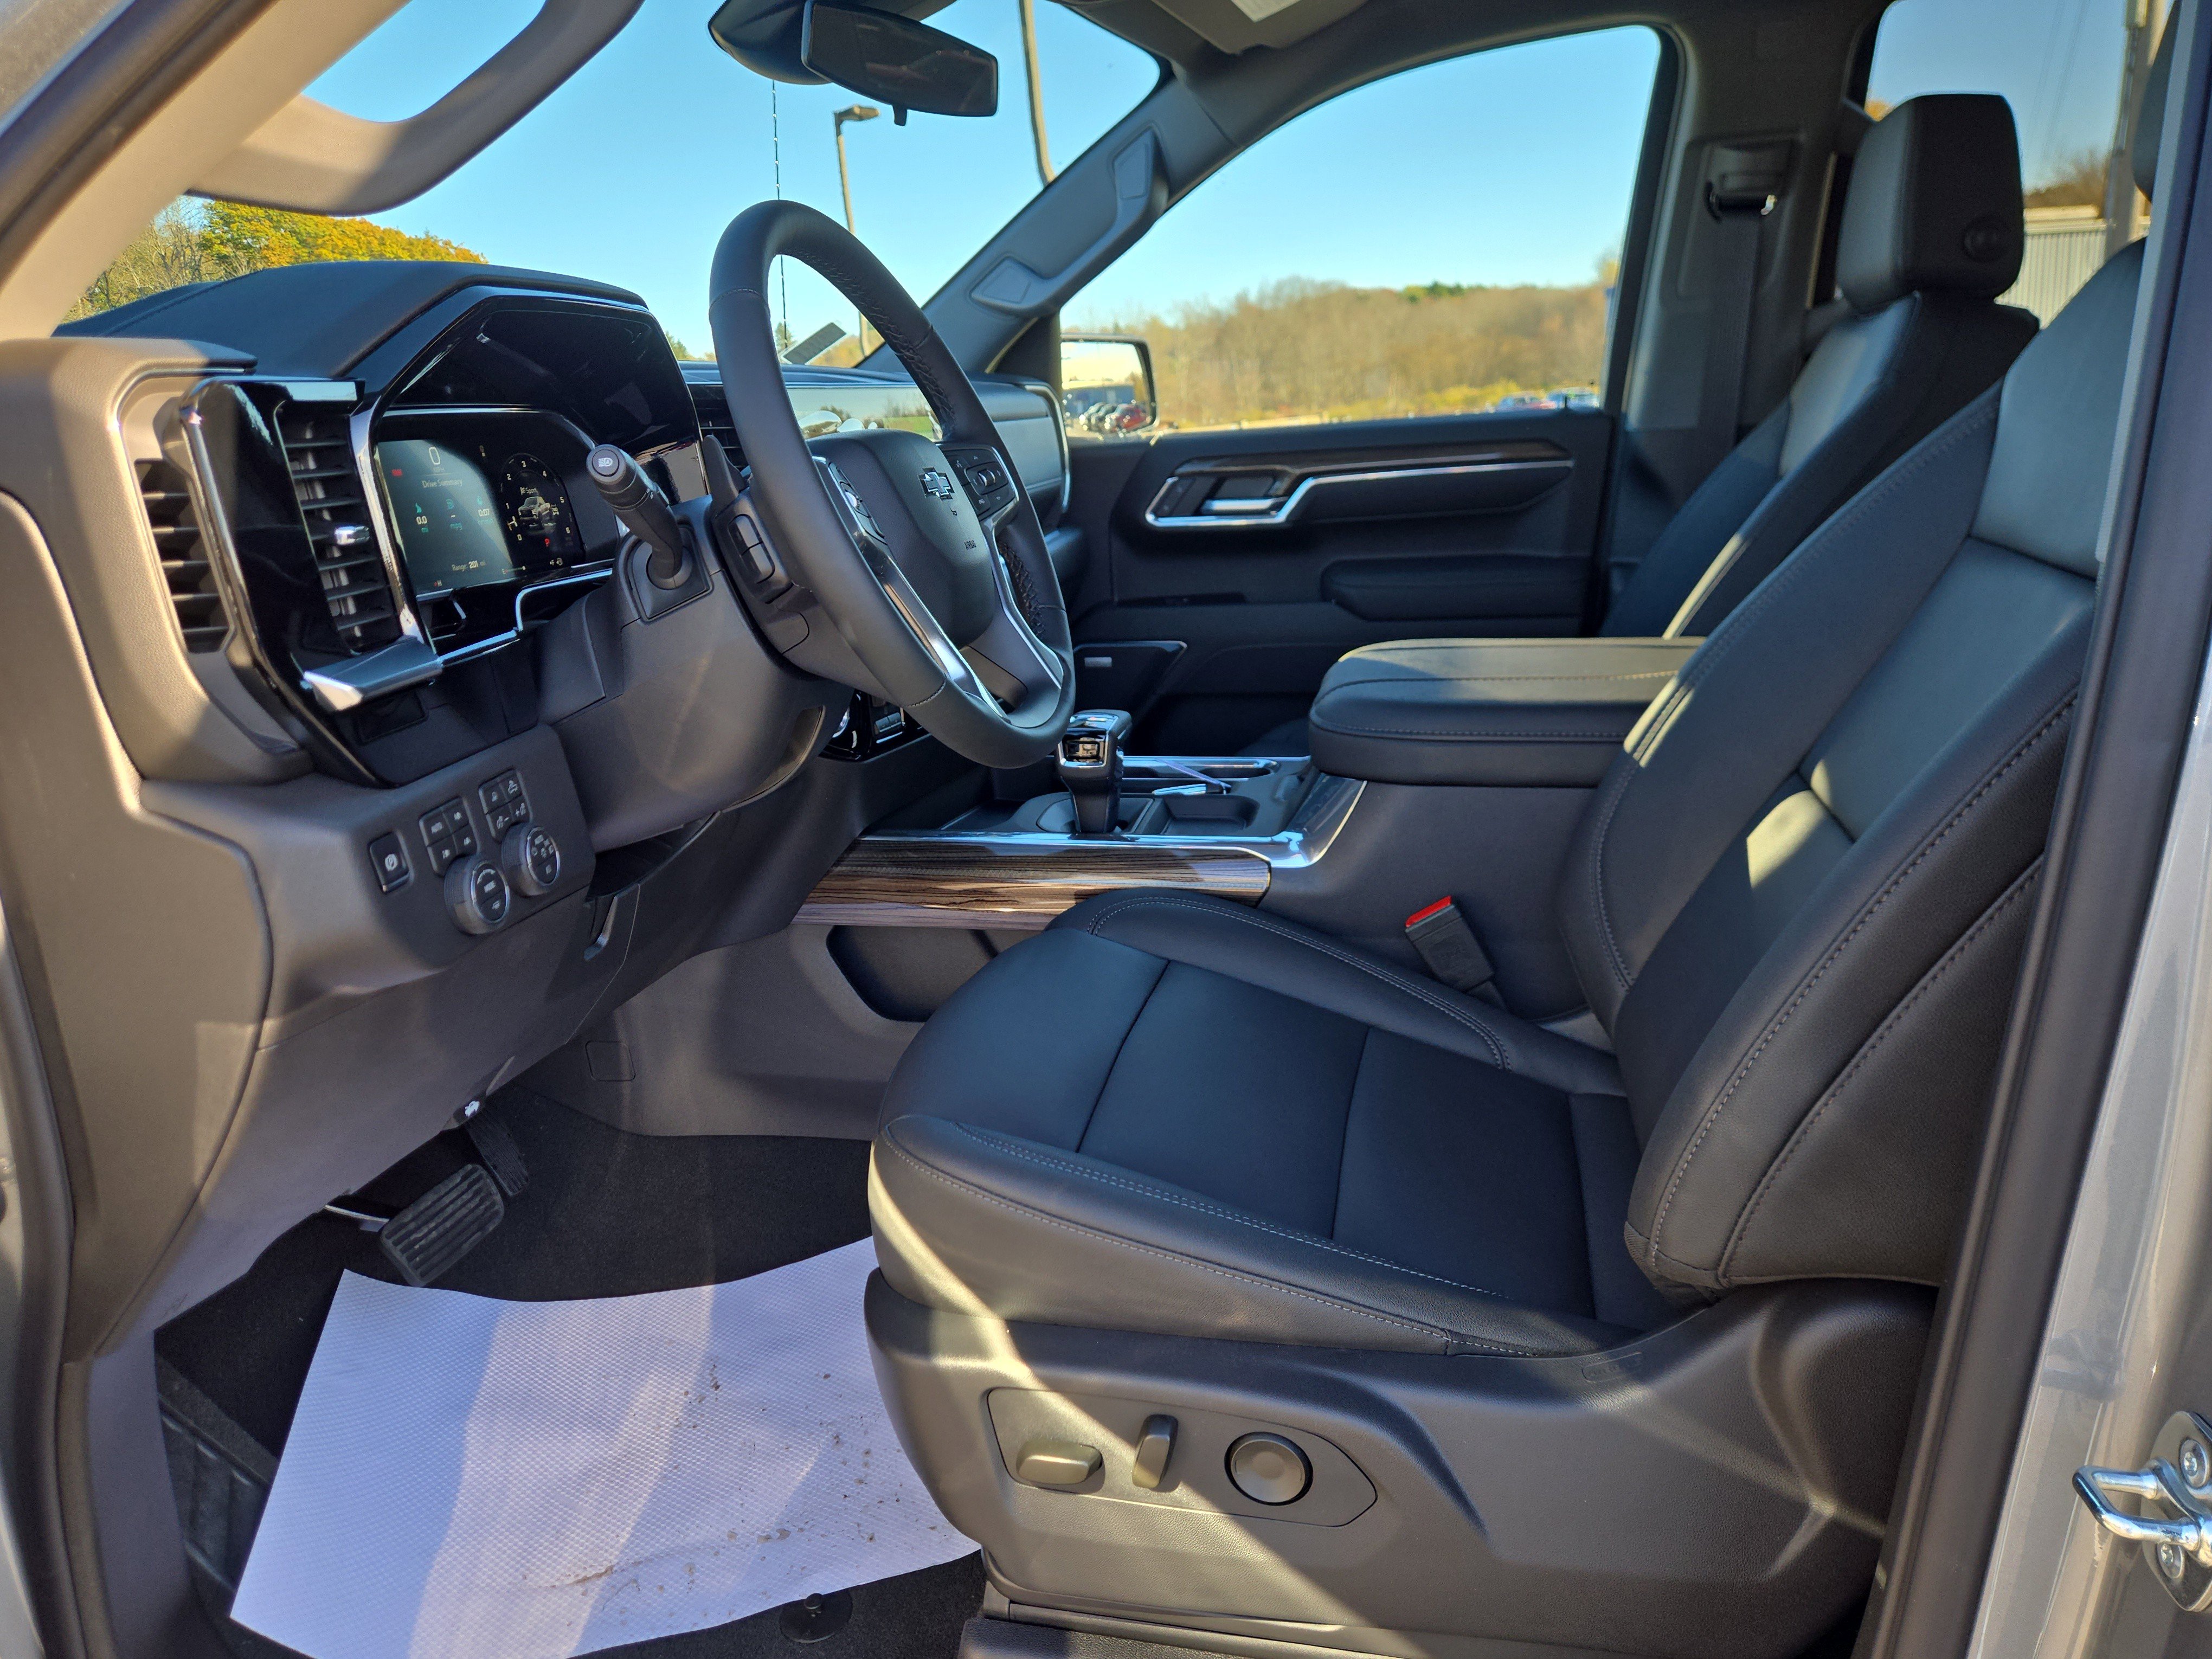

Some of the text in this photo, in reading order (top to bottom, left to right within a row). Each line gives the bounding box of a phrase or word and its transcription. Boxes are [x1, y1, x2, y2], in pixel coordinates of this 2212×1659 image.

[429, 447, 440, 465] 0
[416, 516, 428, 525] 0.0
[468, 560, 479, 569] 201
